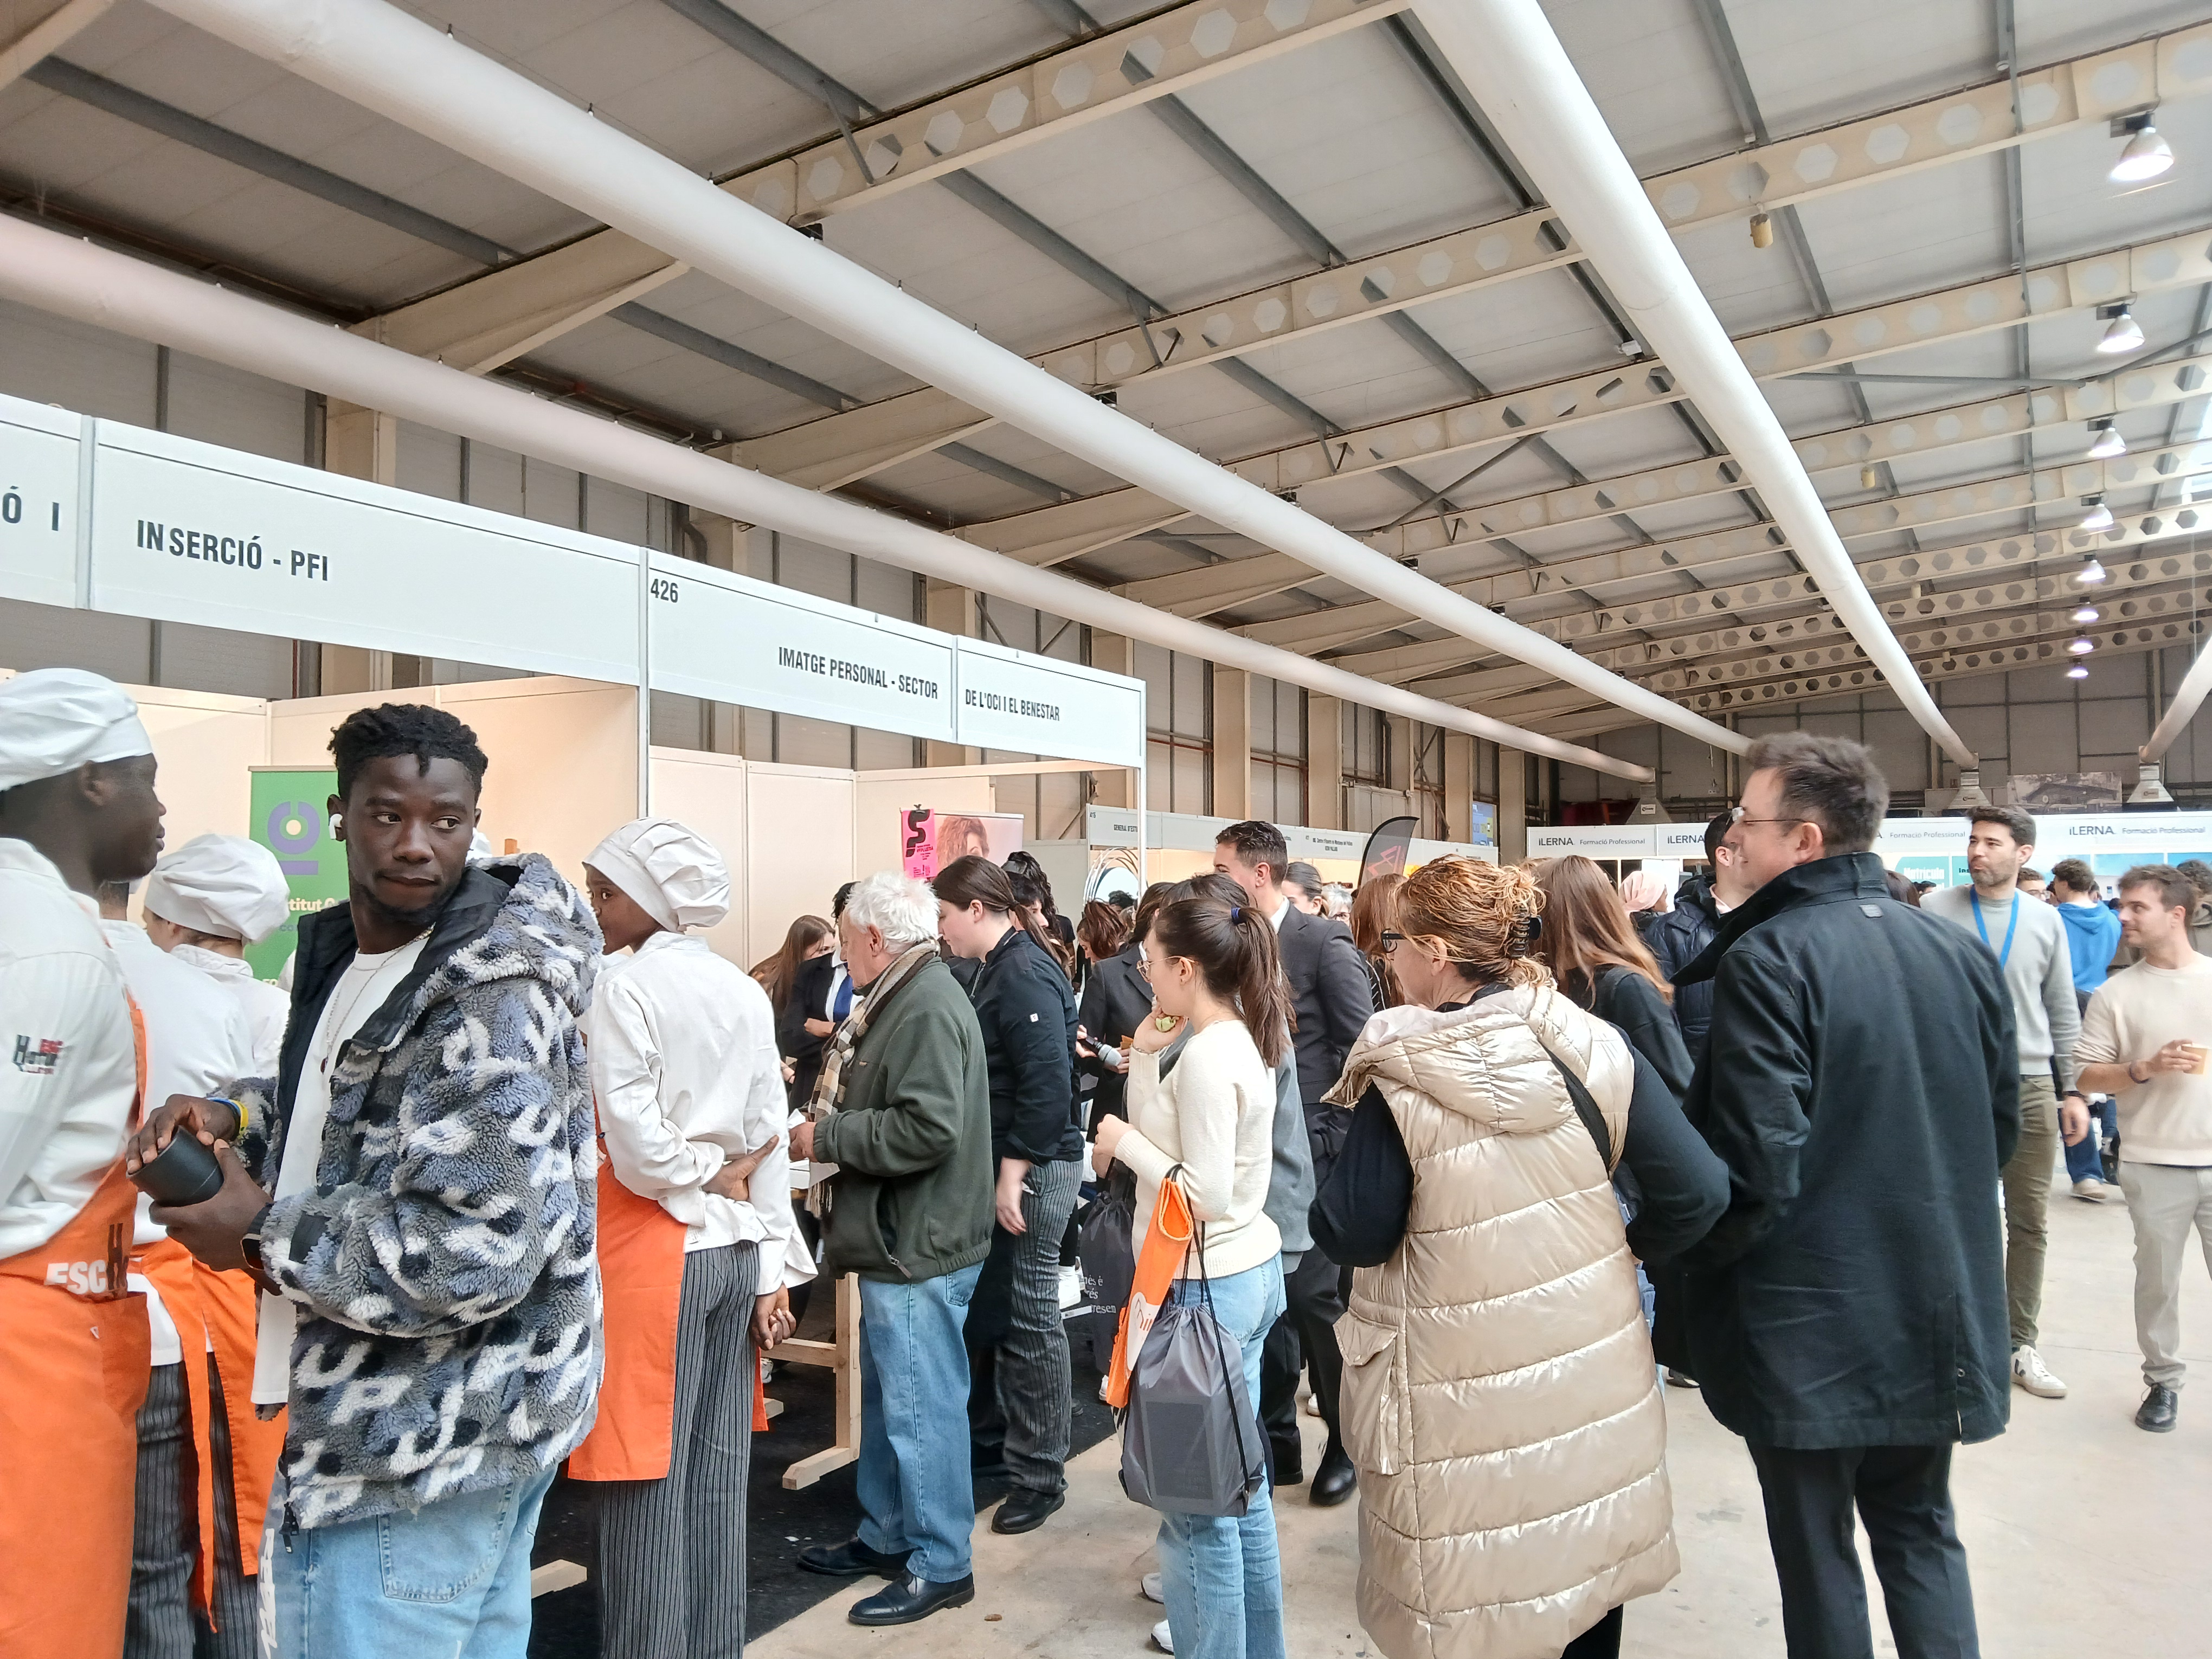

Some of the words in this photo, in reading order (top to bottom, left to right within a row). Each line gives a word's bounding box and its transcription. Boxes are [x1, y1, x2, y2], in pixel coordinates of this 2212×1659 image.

[291, 550, 328, 581] PFI
[650, 578, 679, 603] 426
[779, 646, 826, 675] IMATGE
[829, 658, 888, 688] PERSONAL
[898, 674, 938, 699] SECTOR
[965, 689, 976, 705] DE
[979, 691, 1001, 711] L'OCI
[1004, 696, 1007, 711] I
[1009, 698, 1018, 713] EL
[1021, 699, 1060, 721] BENESTAR
[288, 897, 323, 911] titut
